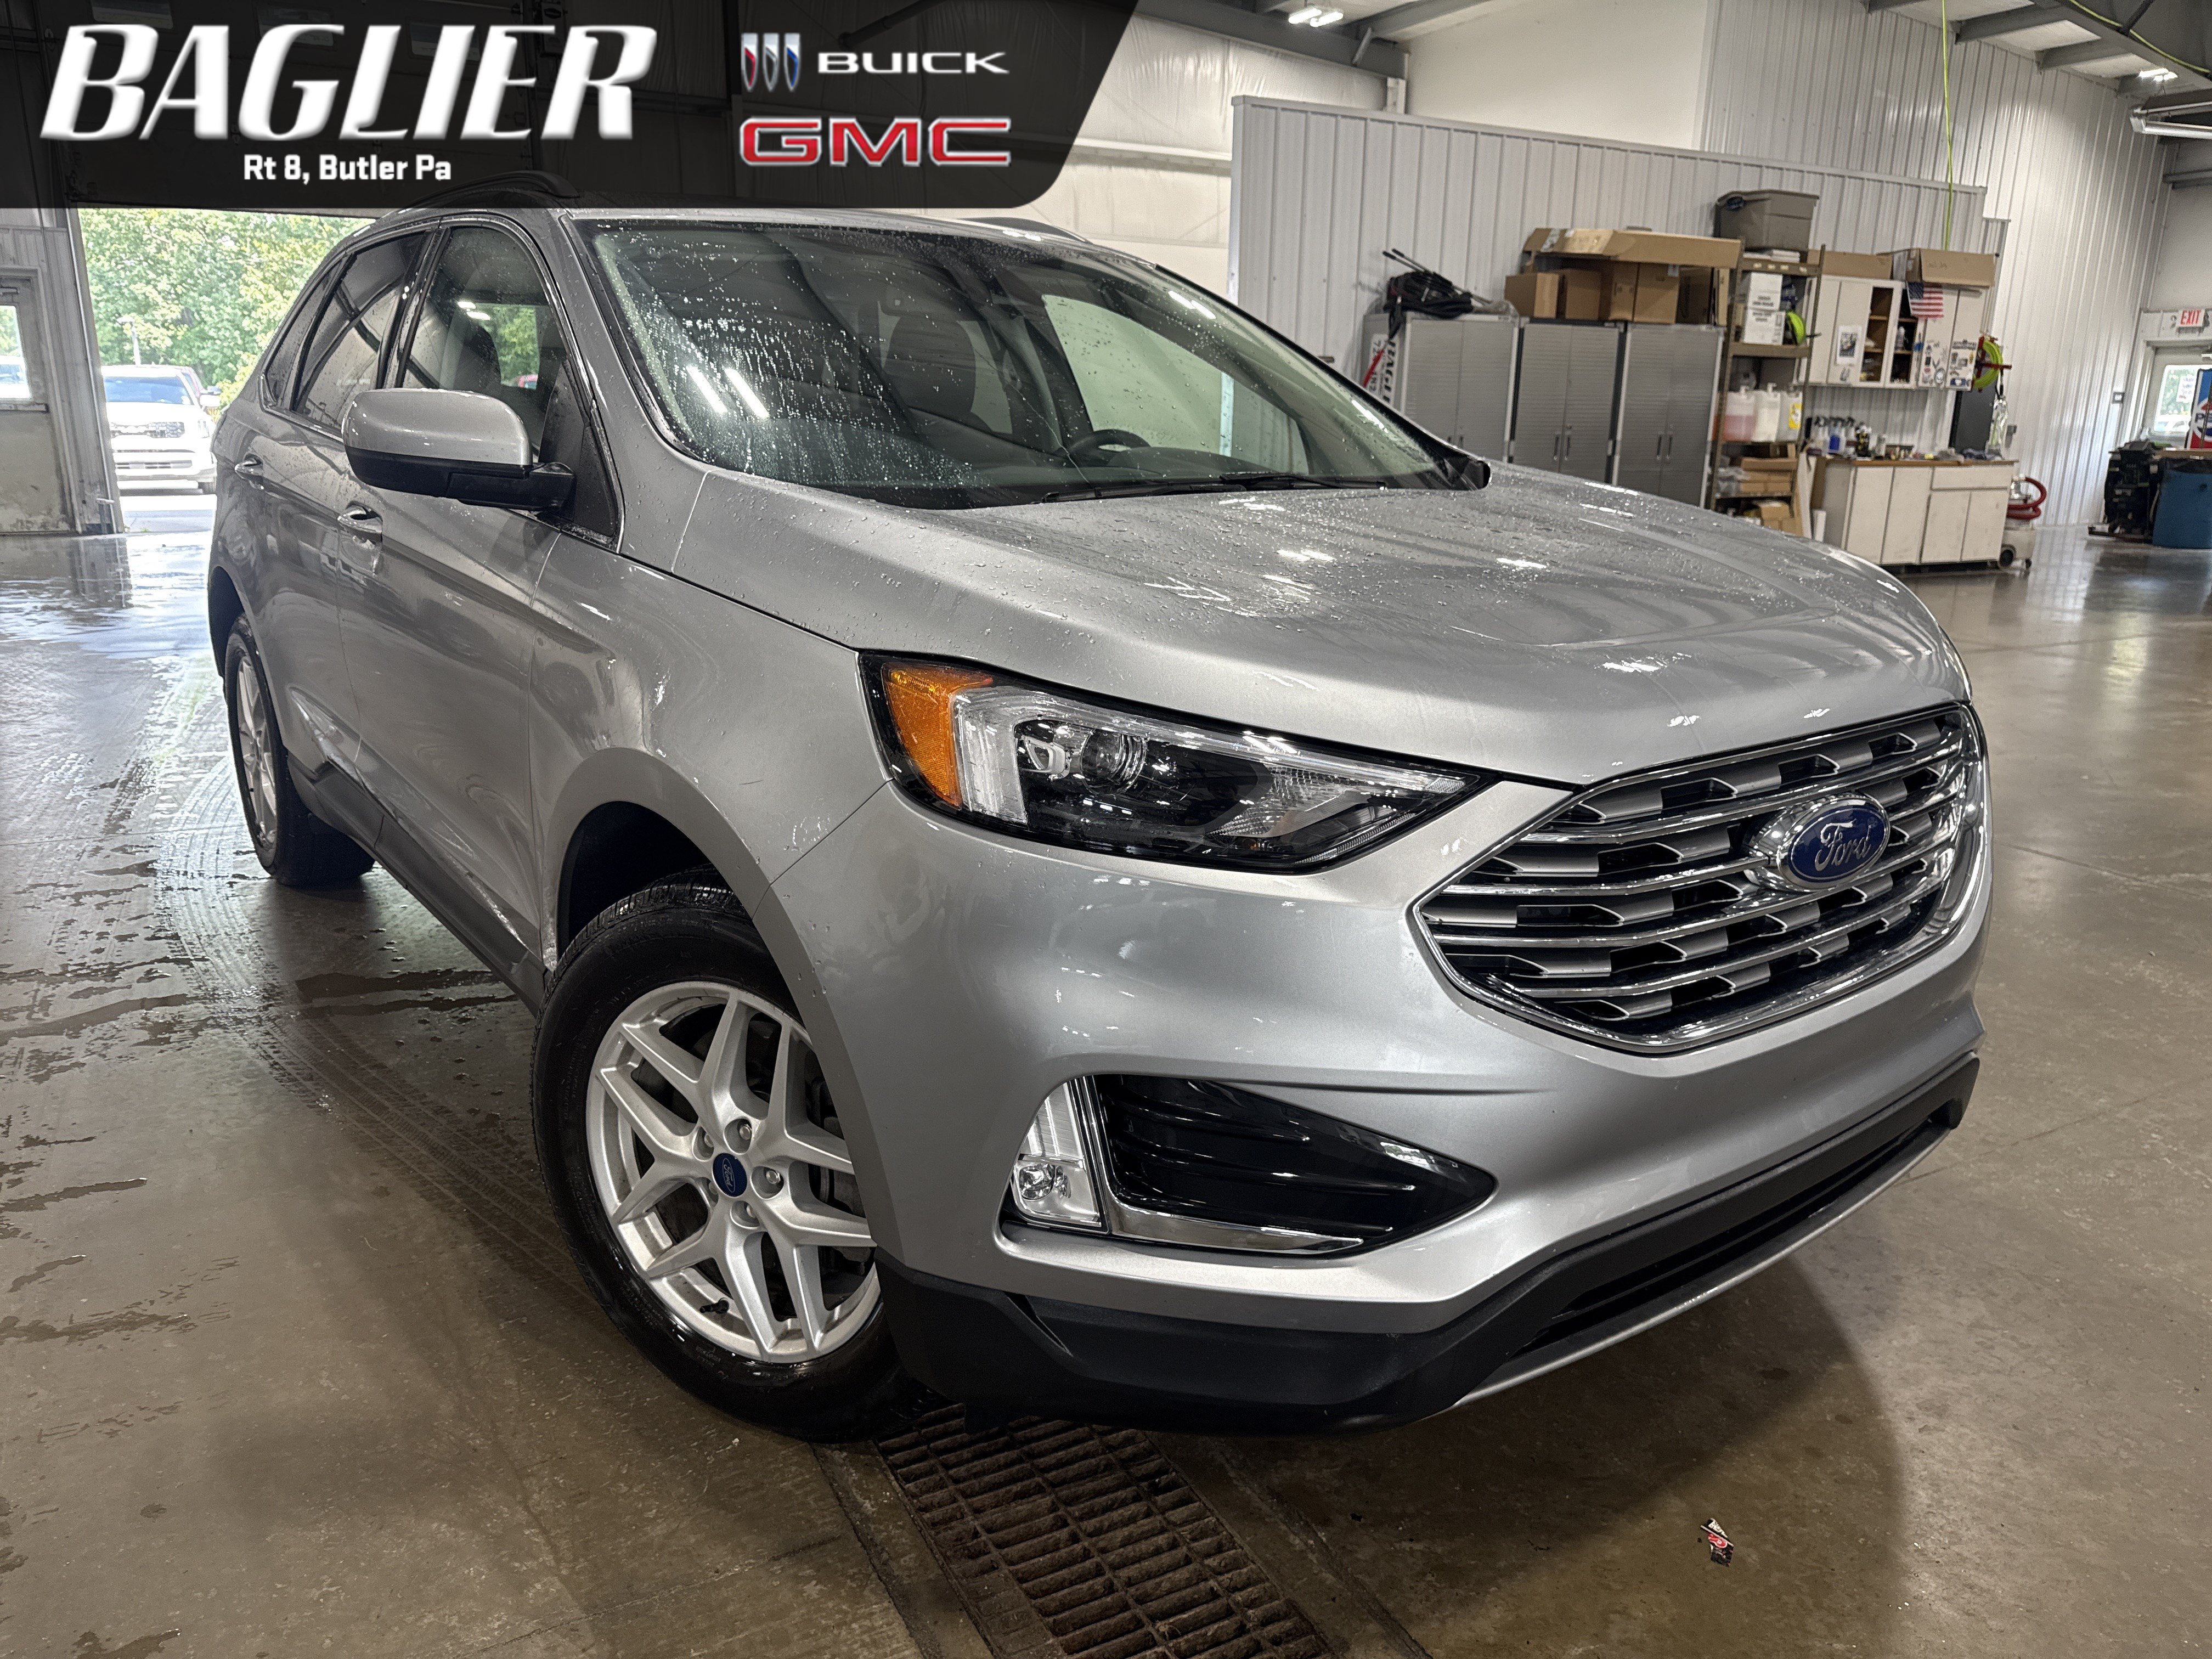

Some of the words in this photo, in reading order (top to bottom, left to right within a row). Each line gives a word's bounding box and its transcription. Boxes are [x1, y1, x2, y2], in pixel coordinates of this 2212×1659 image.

[2180, 309, 2201, 325] EXIT
[1814, 818, 1872, 872] Ford
[724, 1164, 733, 1187] Ford
